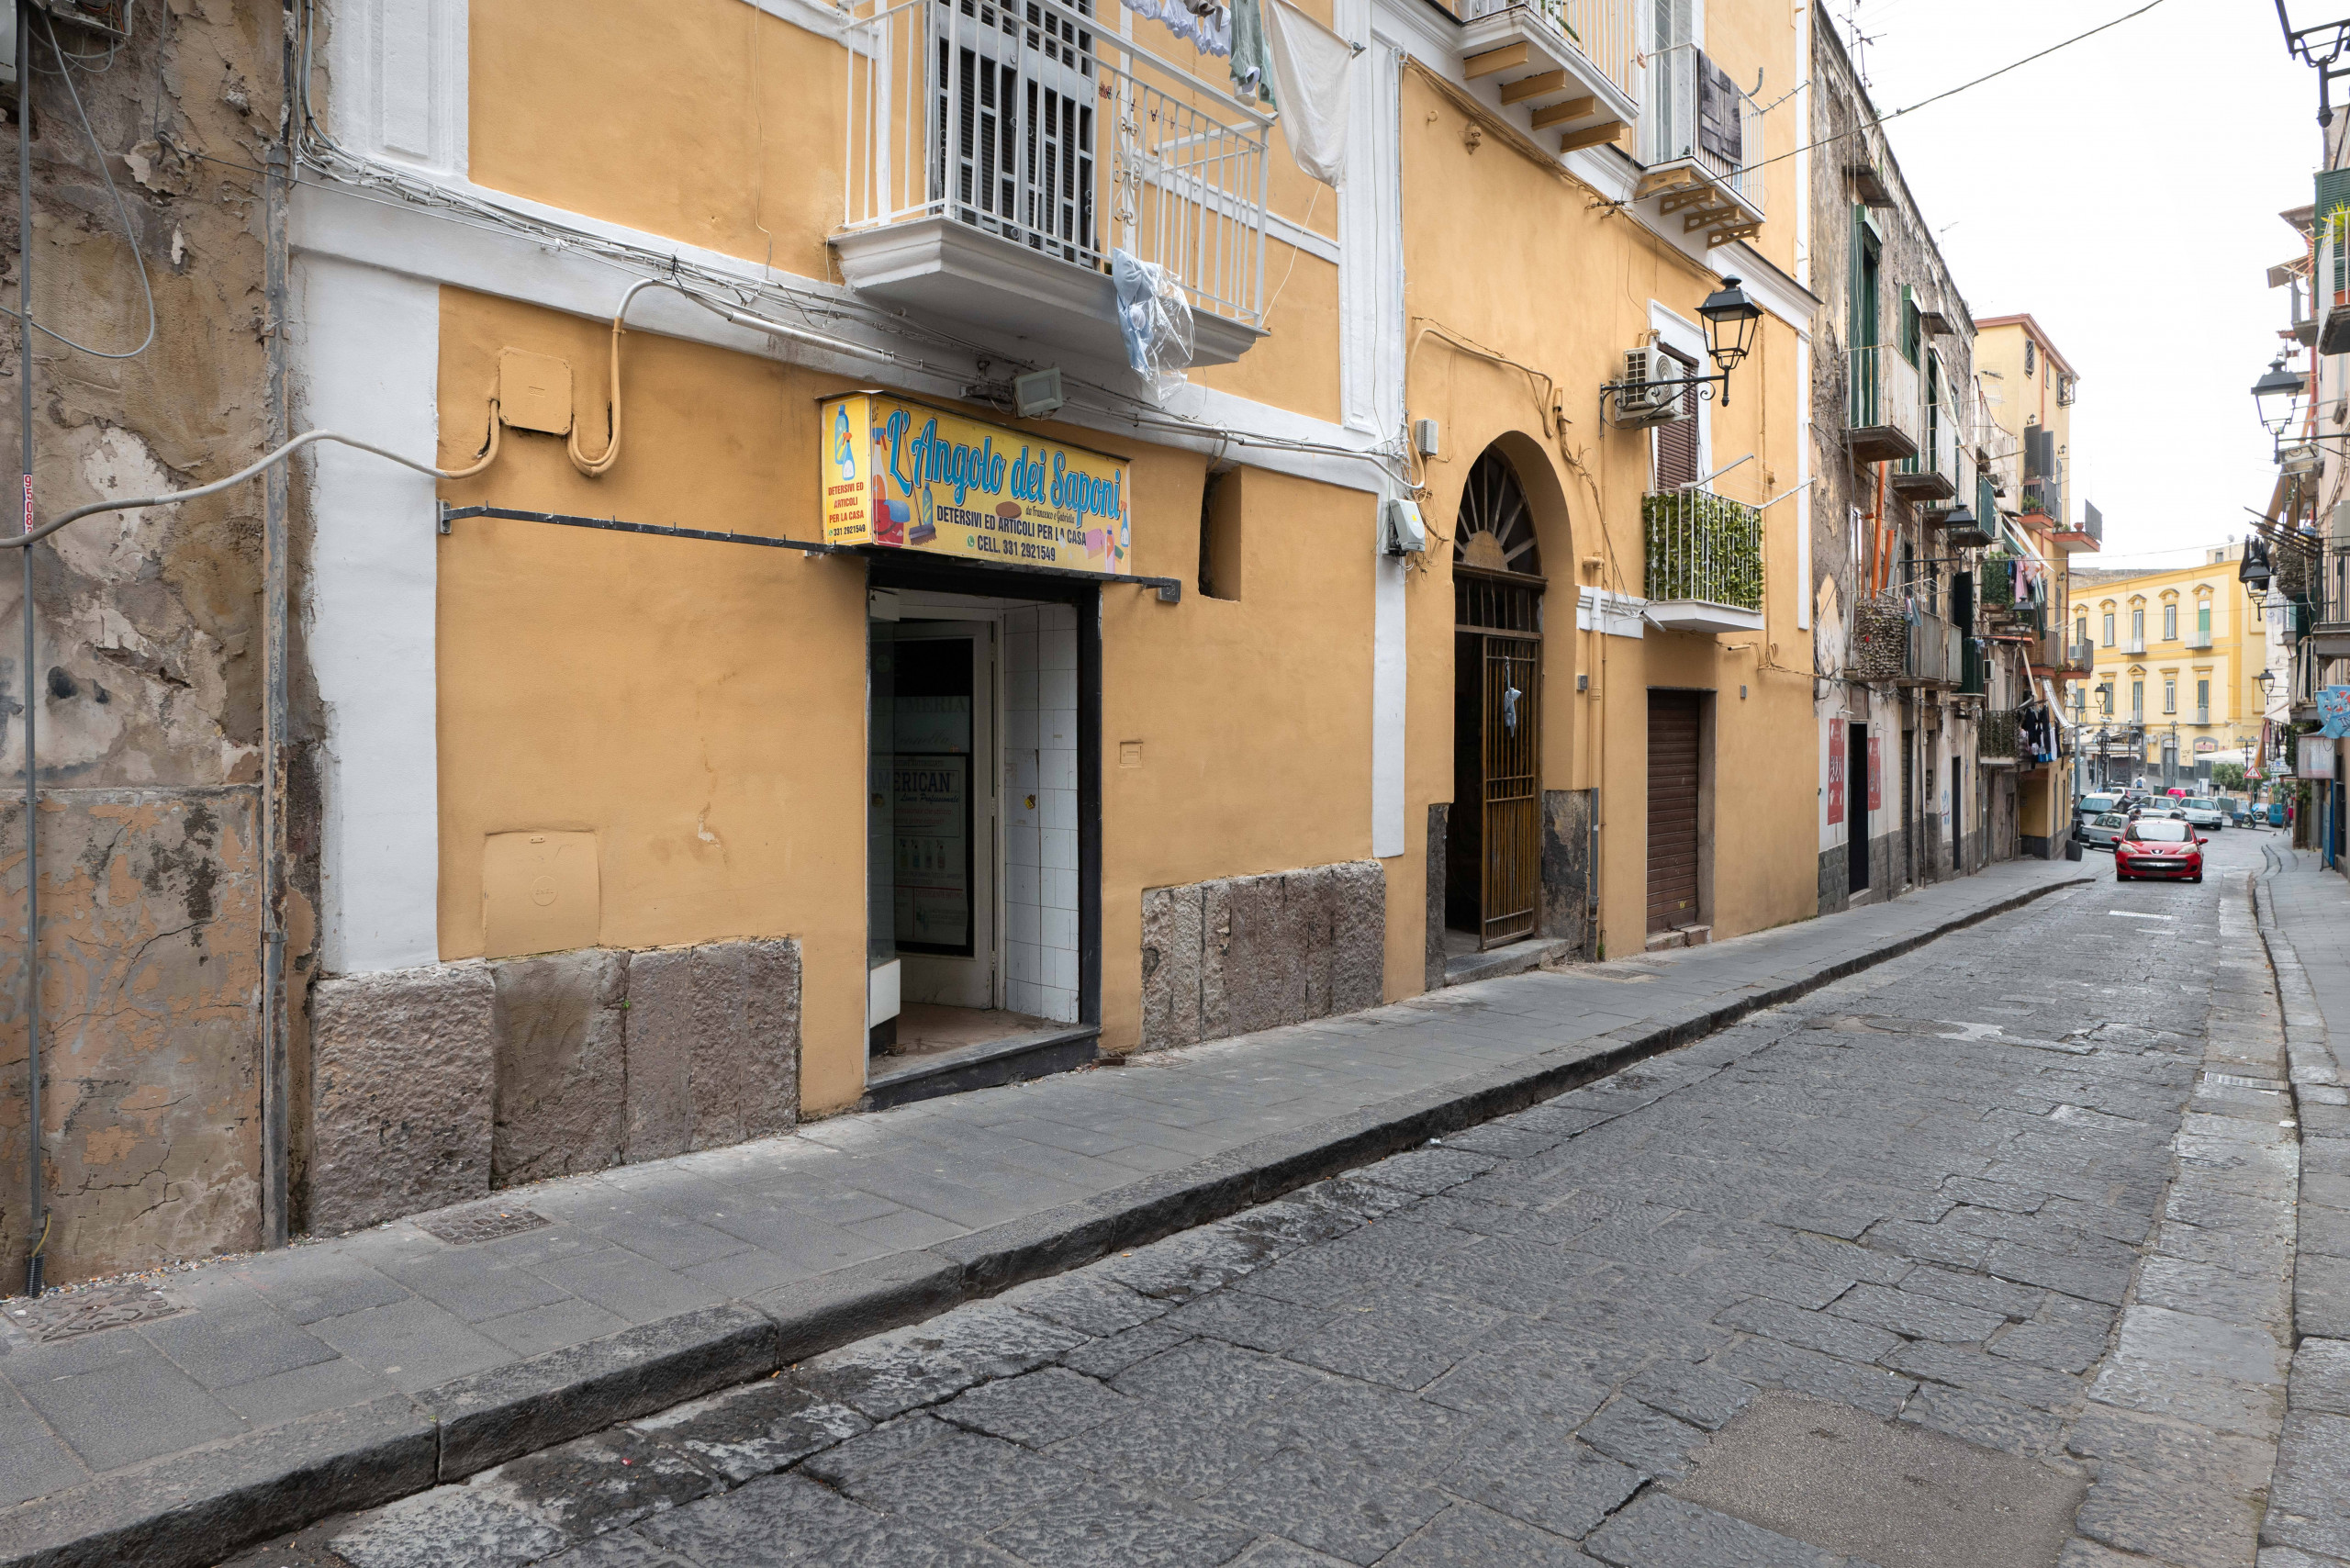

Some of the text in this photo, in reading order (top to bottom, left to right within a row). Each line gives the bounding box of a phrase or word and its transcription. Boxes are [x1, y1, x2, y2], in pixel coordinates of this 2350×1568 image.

[828, 481, 864, 496] DETERSIVI ED
[1010, 445, 1046, 504] dei
[1049, 450, 1121, 529] Saponi
[834, 497, 858, 509] ARTICOLI
[829, 510, 865, 523] PER LA CASA
[1033, 506, 1053, 520] Francesco
[1057, 510, 1075, 524] Gabriella
[834, 524, 866, 536] 331 2921549
[936, 505, 1087, 546] DETERSIVI ED ARTICOLI PER LA CASA
[977, 535, 1056, 561] CELL. 331 2921549
